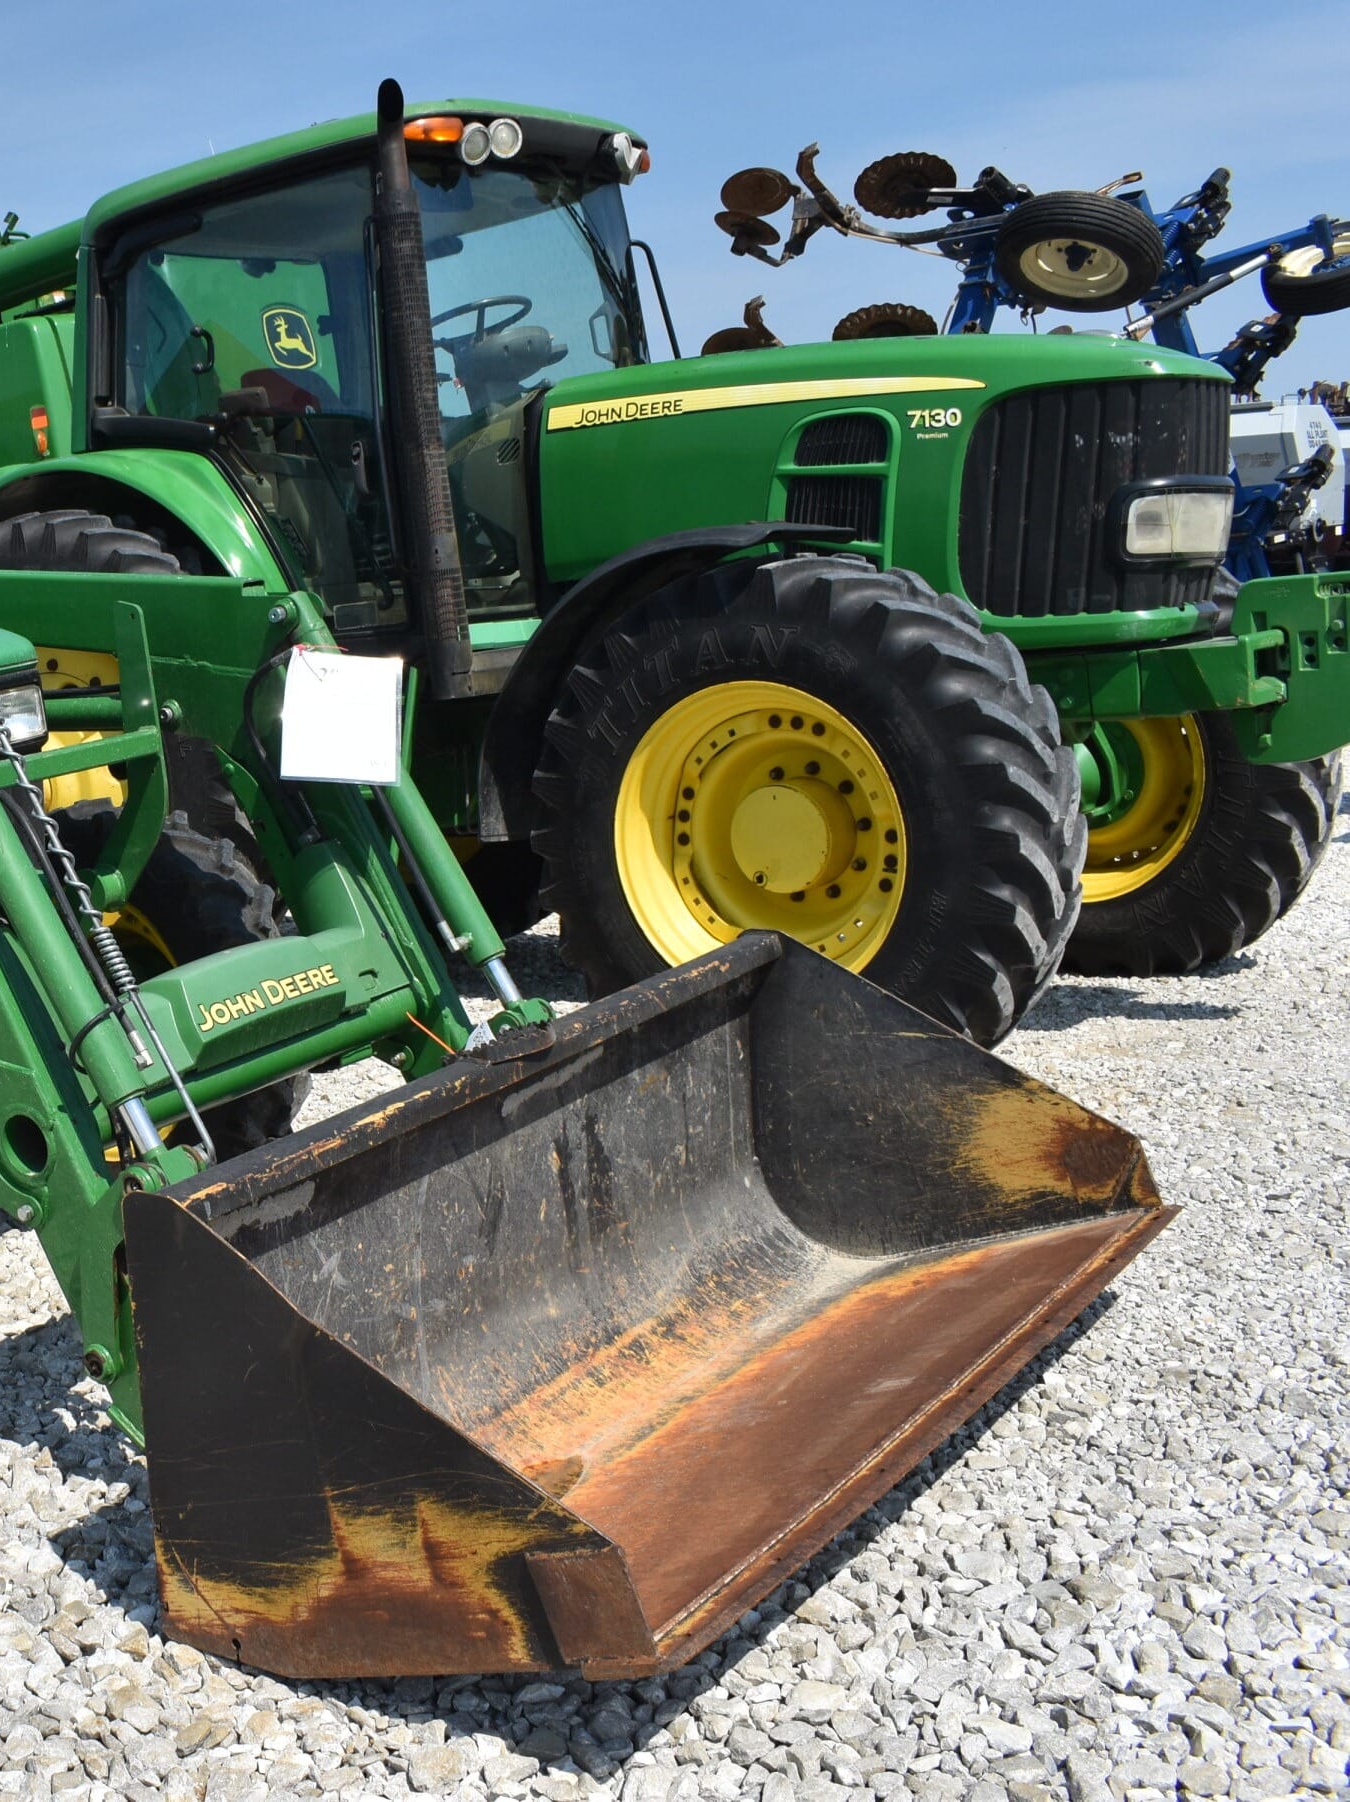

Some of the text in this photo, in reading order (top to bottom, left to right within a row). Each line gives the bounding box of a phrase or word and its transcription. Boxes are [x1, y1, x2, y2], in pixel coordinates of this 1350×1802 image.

[575, 399, 683, 425] JOHN DEERE
[906, 407, 962, 429] 7130
[916, 431, 949, 440] Premium
[587, 622, 801, 756] TITAN
[198, 963, 340, 1033] JOHN DEERE
